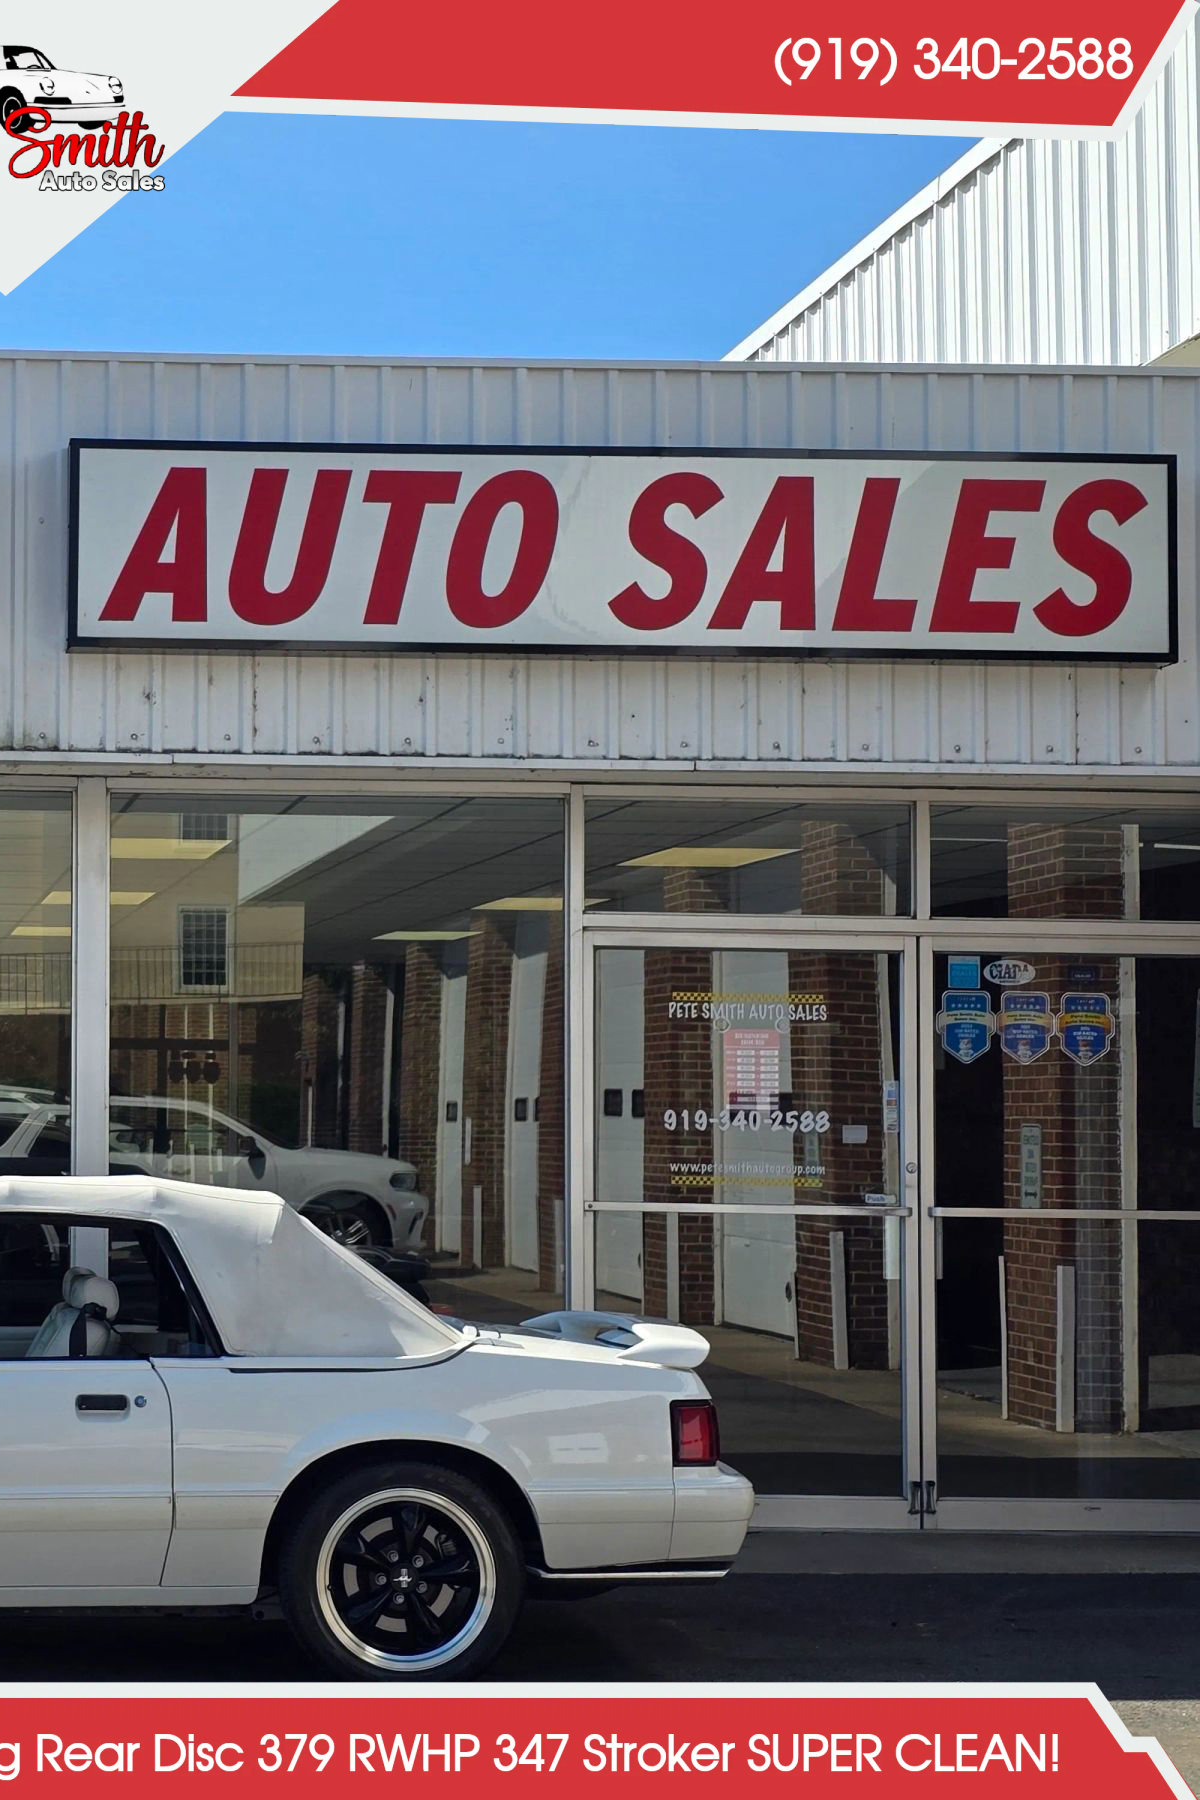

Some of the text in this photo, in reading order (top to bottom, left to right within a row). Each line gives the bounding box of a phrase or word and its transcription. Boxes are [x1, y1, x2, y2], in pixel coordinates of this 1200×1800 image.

[98, 466, 1149, 637] AUTO SALES
[668, 1002, 828, 1021] PETE SMITH AUTO SALES
[663, 1109, 831, 1133] 919-340-2588
